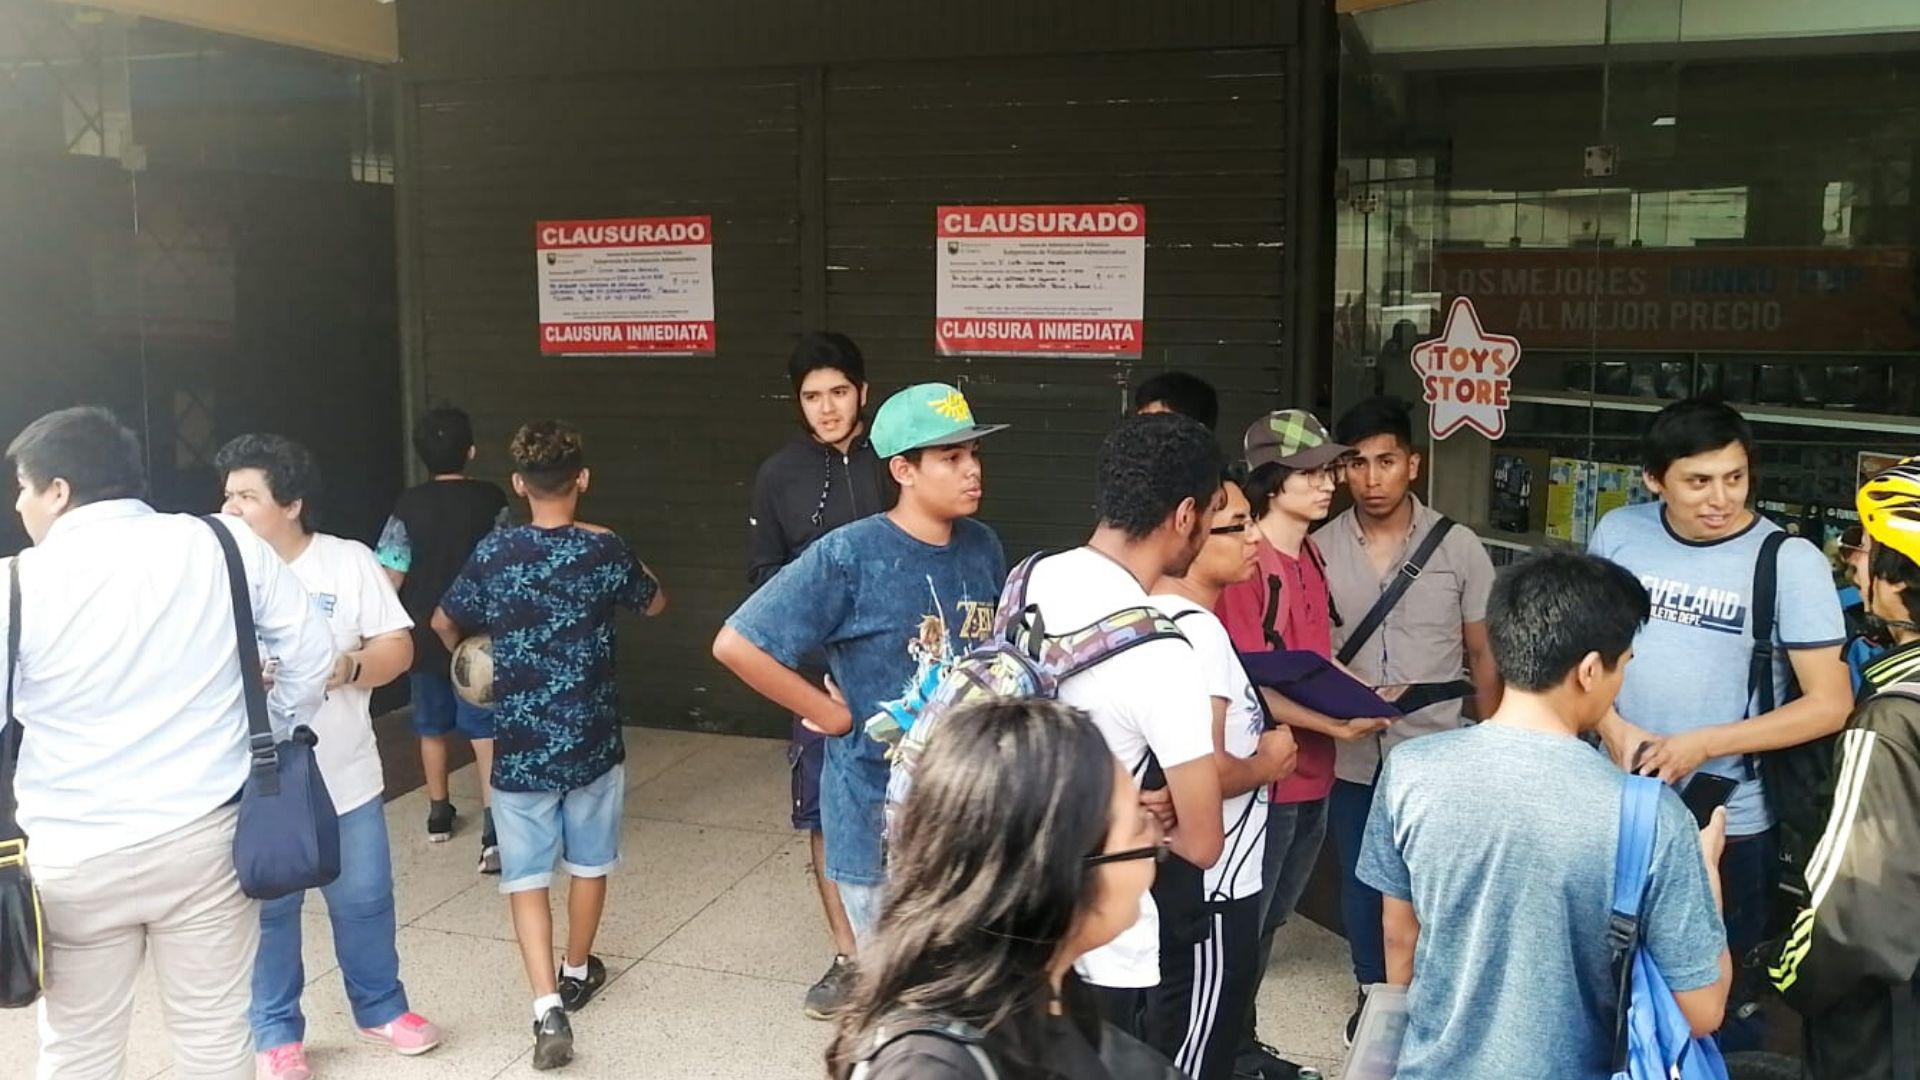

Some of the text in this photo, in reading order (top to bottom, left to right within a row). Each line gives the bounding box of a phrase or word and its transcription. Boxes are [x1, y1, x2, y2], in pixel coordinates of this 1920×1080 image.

[542, 222, 705, 245] CLAUSURADO
[944, 211, 1139, 233] CLAUSURADO
[1501, 267, 1648, 295] MEJORES
[1515, 301, 1783, 331] AL MEJOR PRECIO
[545, 324, 708, 342] CLAUSURA INMEDIATA
[942, 321, 1135, 341] CLAUSURA INMEDIATA
[1425, 375, 1509, 407] STORE
